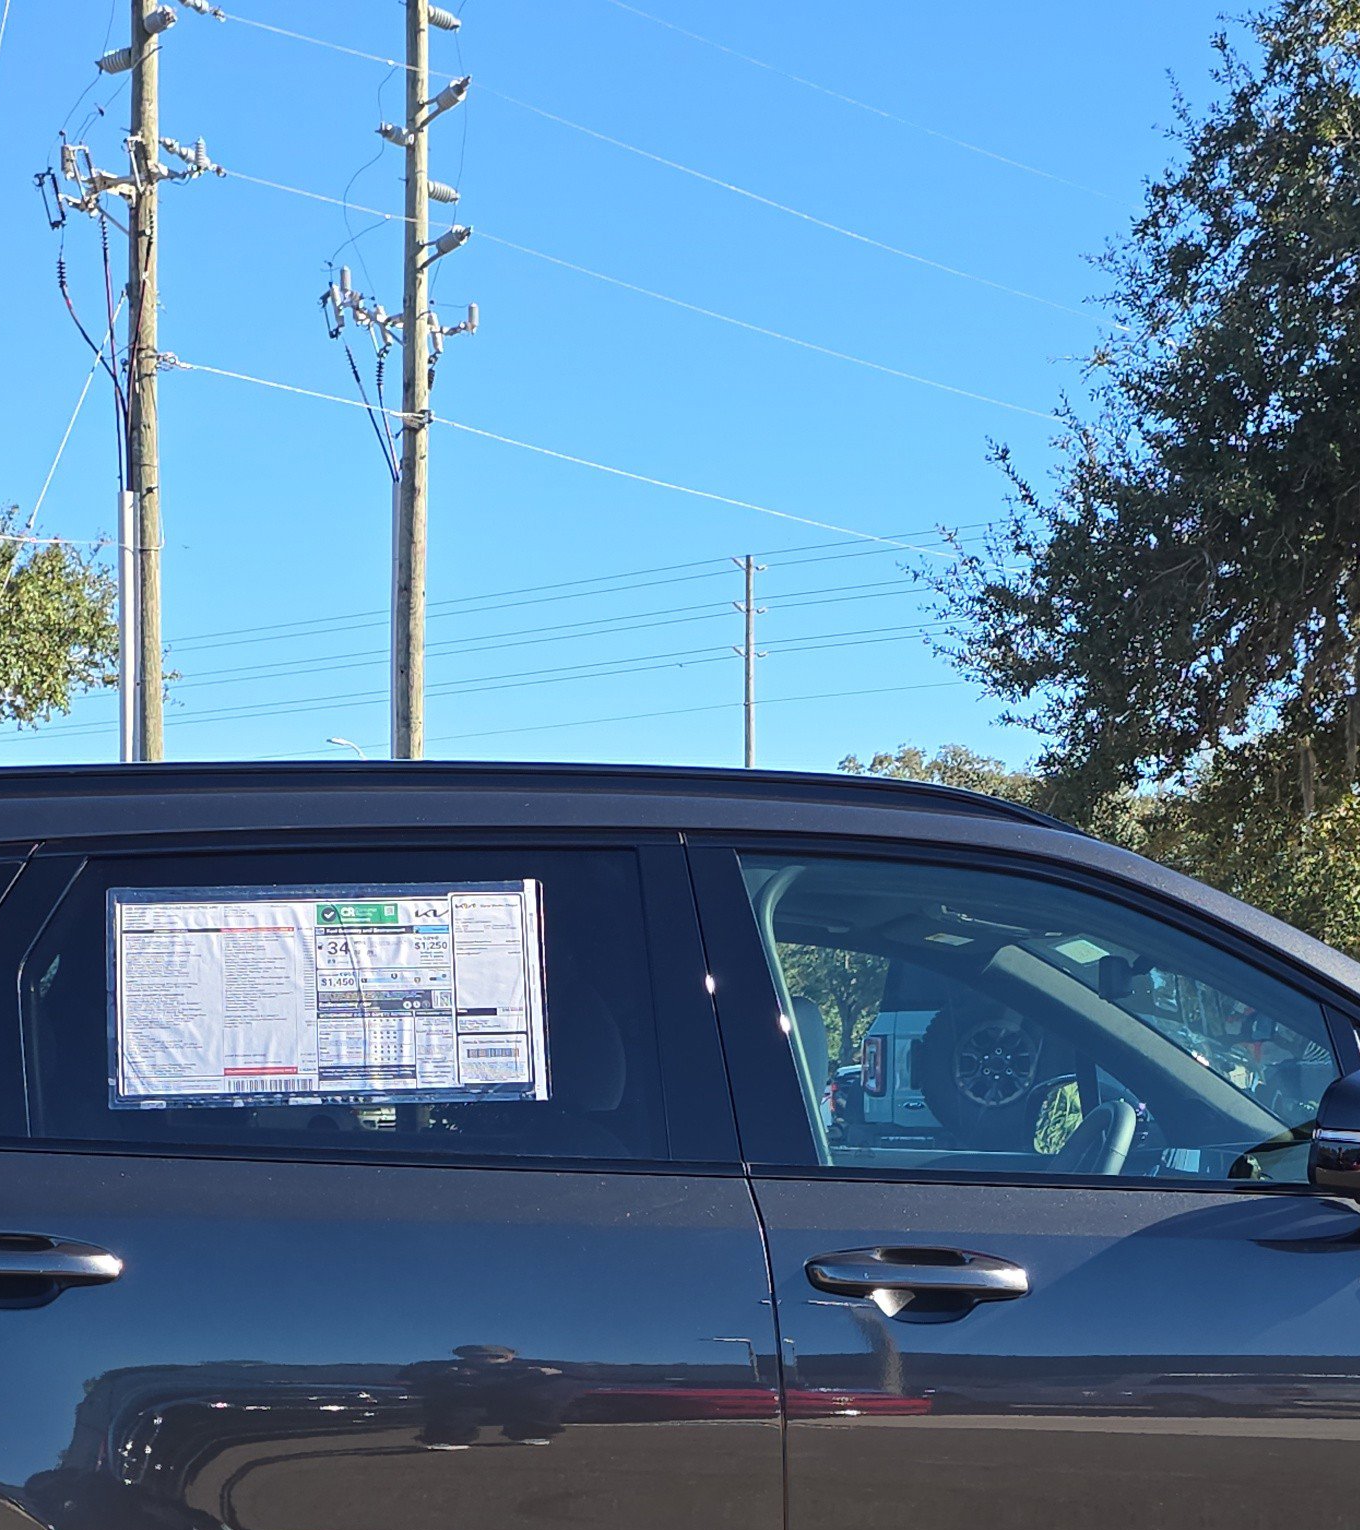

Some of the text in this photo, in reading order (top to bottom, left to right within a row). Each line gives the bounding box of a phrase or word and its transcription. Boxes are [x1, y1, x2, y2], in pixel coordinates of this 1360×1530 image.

[327, 941, 350, 955] 34
[414, 941, 448, 951] $1,250
[321, 977, 355, 988] $1,450
